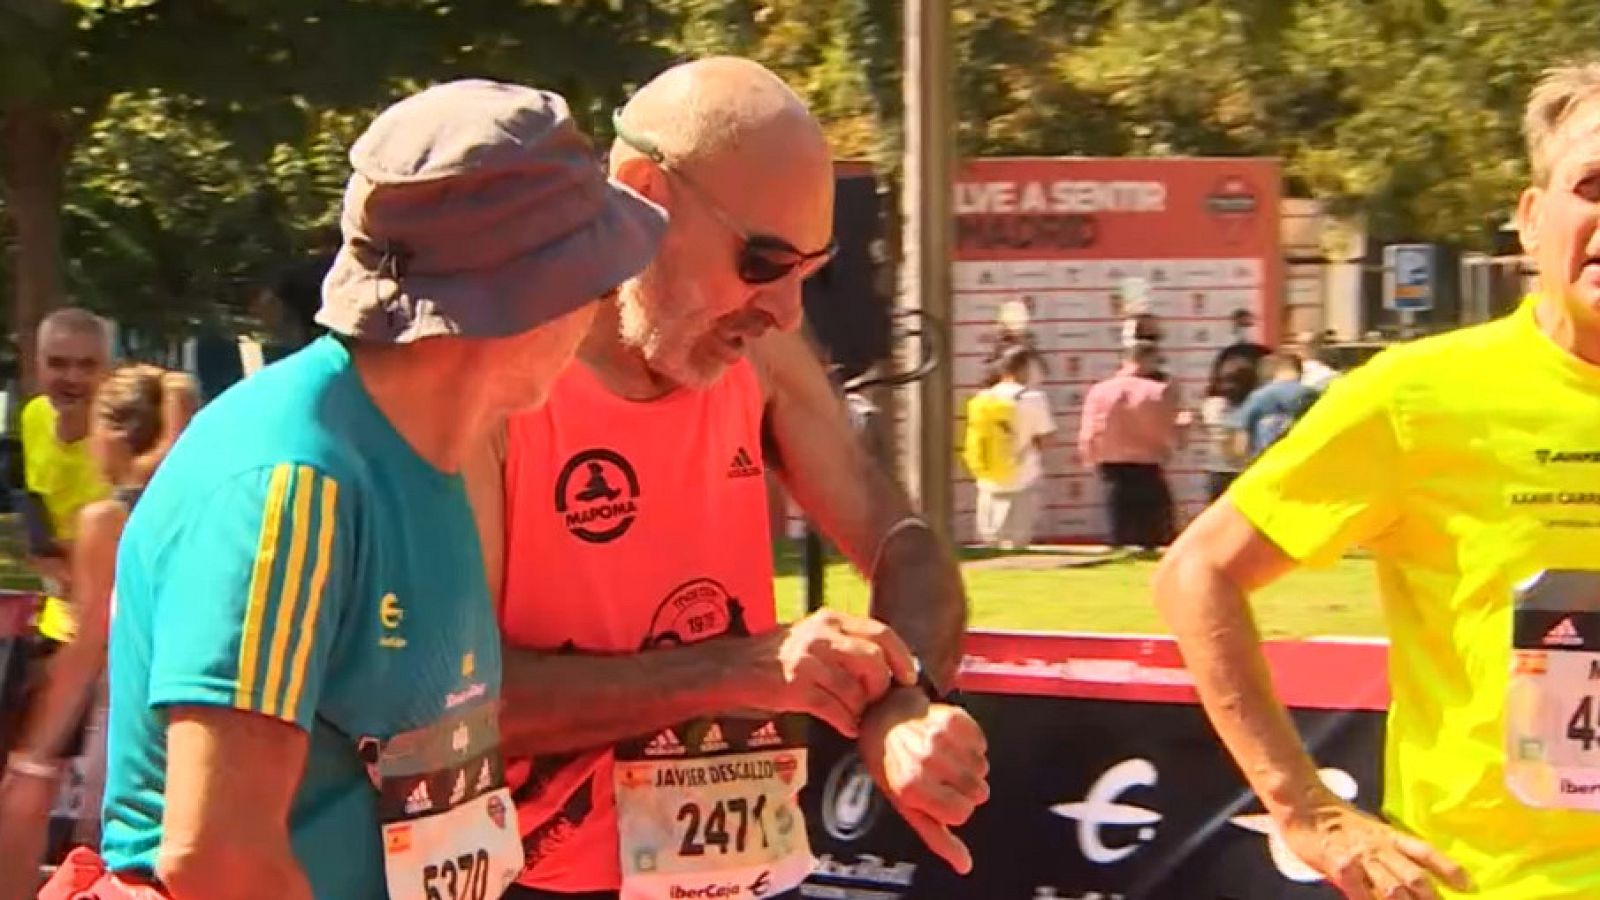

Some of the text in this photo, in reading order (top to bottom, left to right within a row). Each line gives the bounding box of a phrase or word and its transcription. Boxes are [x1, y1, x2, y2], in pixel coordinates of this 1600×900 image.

[1019, 181, 1047, 211] A
[1049, 180, 1166, 212] SENTIR
[566, 501, 637, 527] MAPOMA
[655, 760, 774, 788] JAVIER DESCALZO
[676, 794, 770, 857] 2471
[422, 848, 490, 900] 5370
